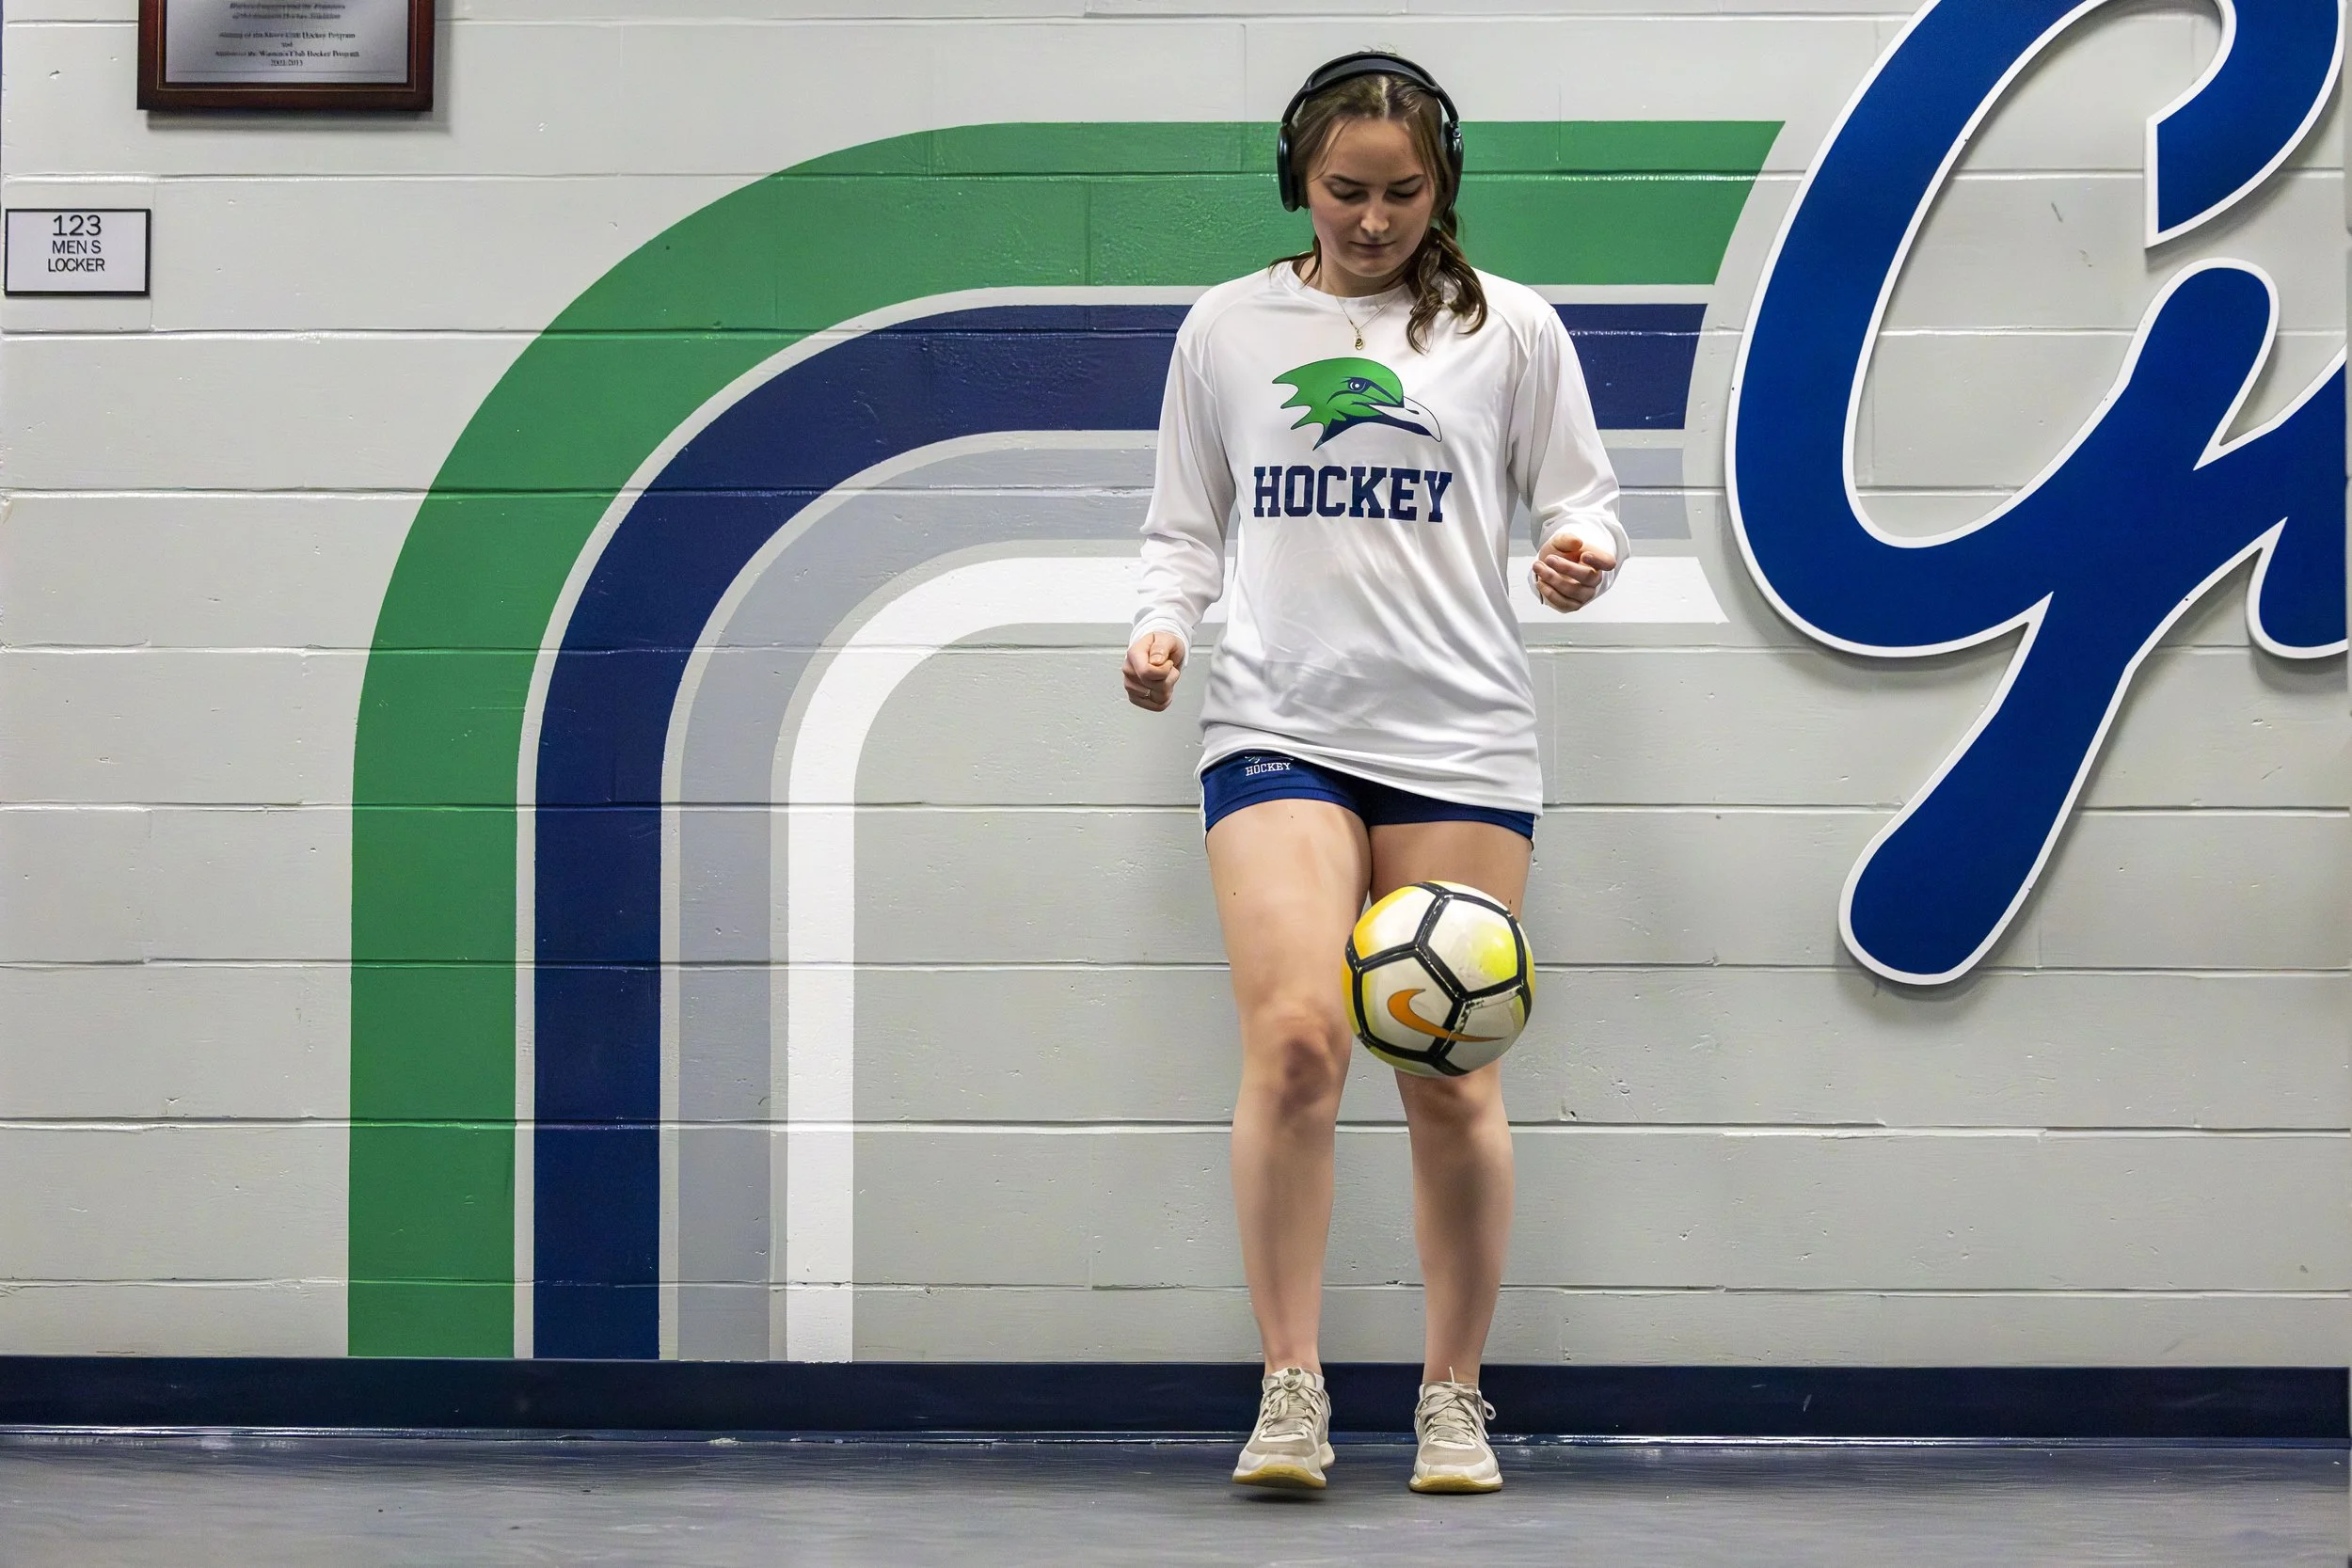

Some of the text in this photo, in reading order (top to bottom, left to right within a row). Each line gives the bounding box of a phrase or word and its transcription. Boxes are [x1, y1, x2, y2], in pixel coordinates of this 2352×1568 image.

[53, 214, 102, 236] 123
[48, 258, 105, 272] LOCKER
[1253, 465, 1453, 523] HOCKEY
[1245, 762, 1291, 777] HOCKEY
